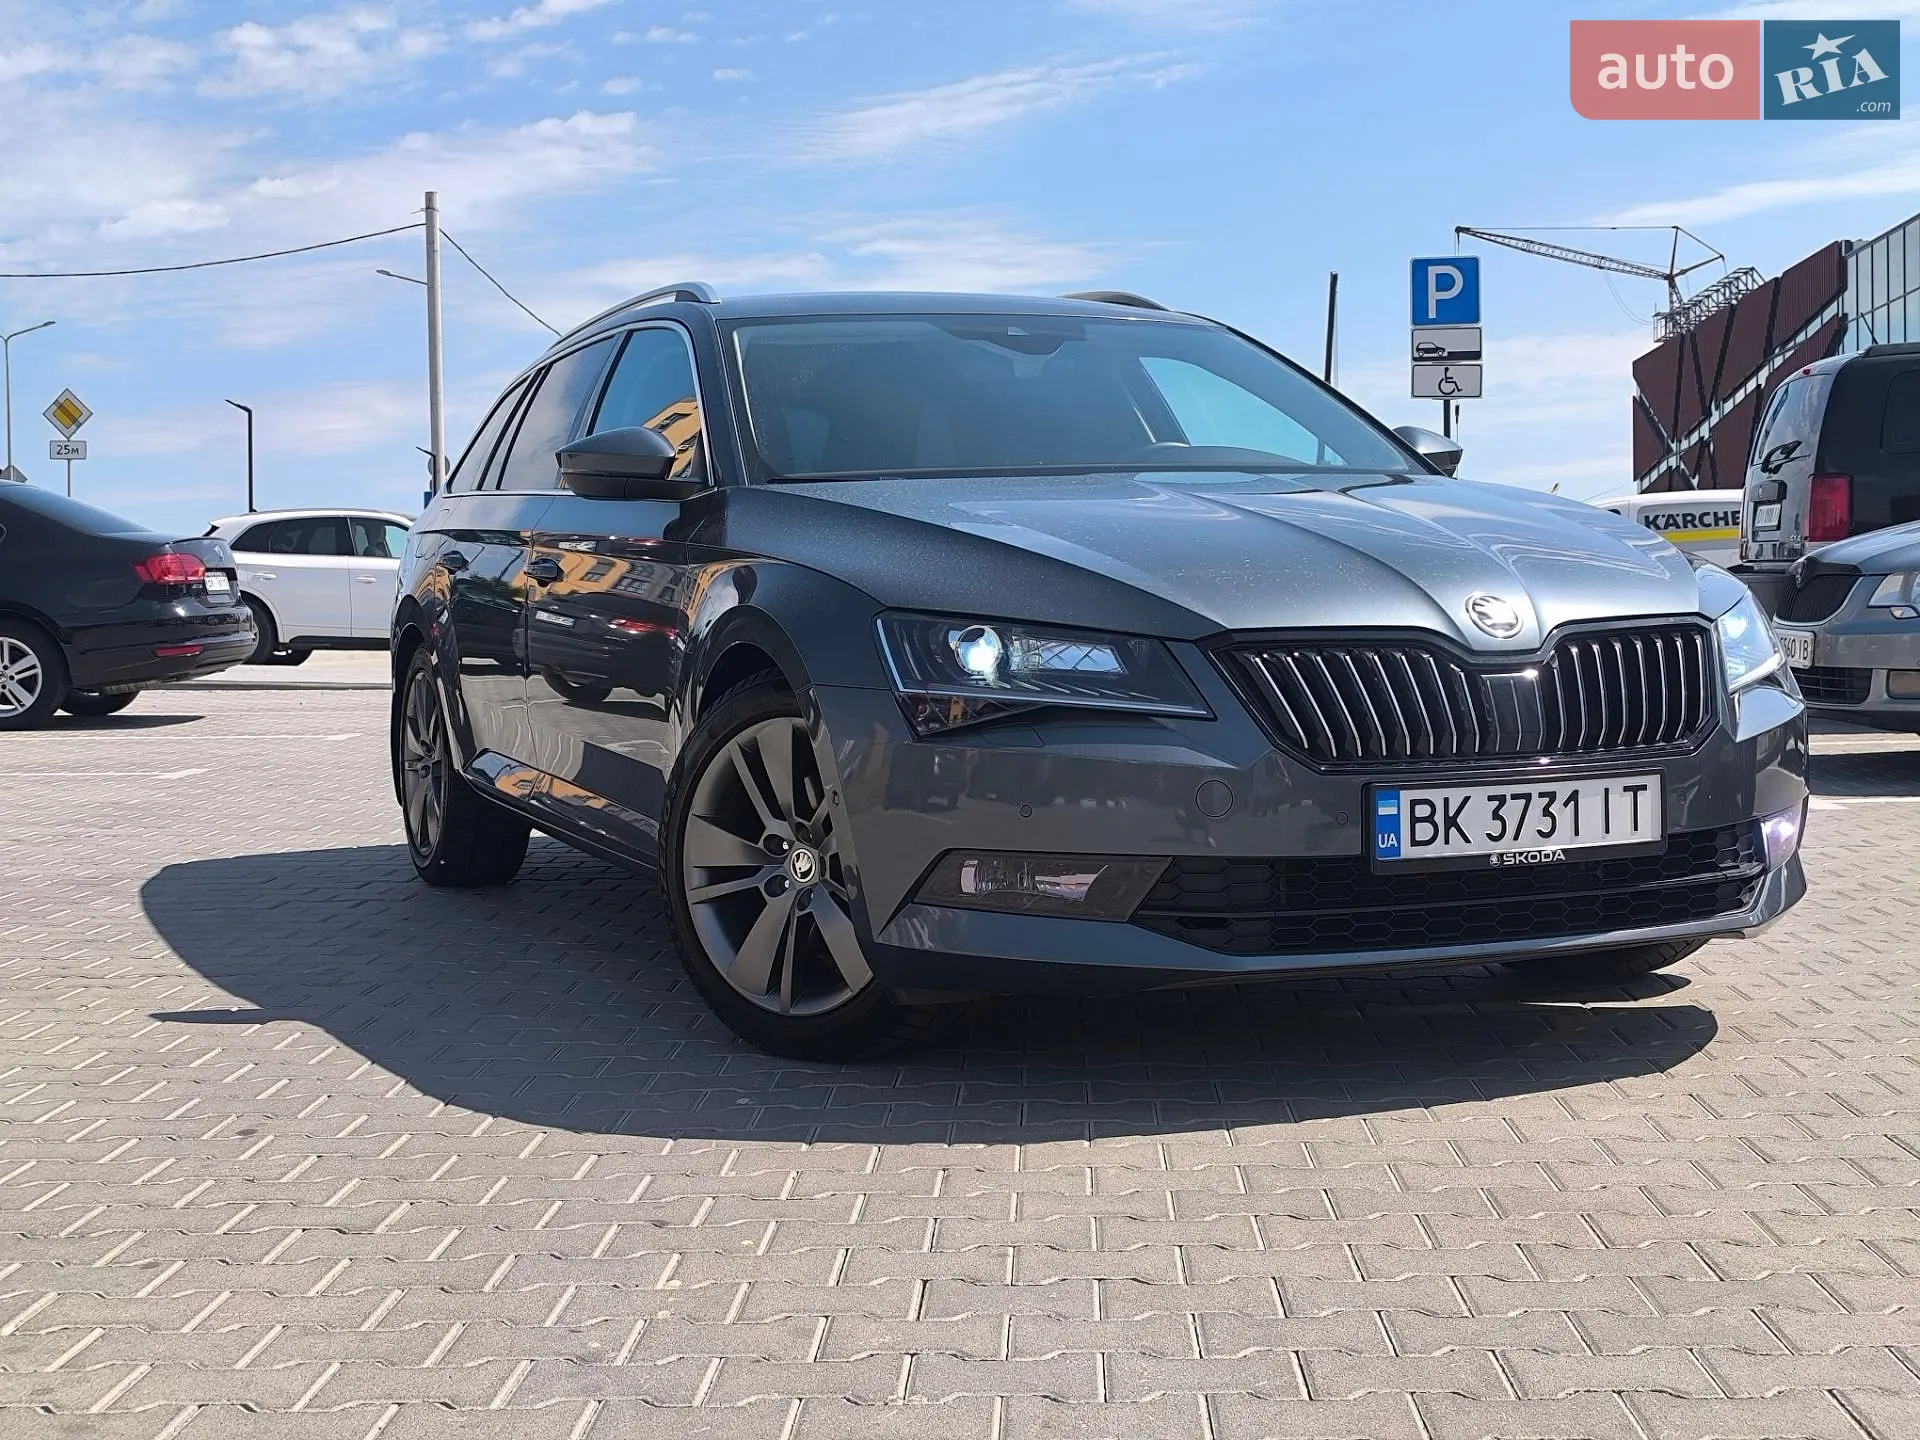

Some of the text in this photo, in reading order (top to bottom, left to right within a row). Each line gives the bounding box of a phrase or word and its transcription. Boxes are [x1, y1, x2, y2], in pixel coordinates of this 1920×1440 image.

[1428, 265, 1463, 318] P
[1378, 833, 1398, 848] UA
[1409, 784, 1648, 847] BK 3731 IT
